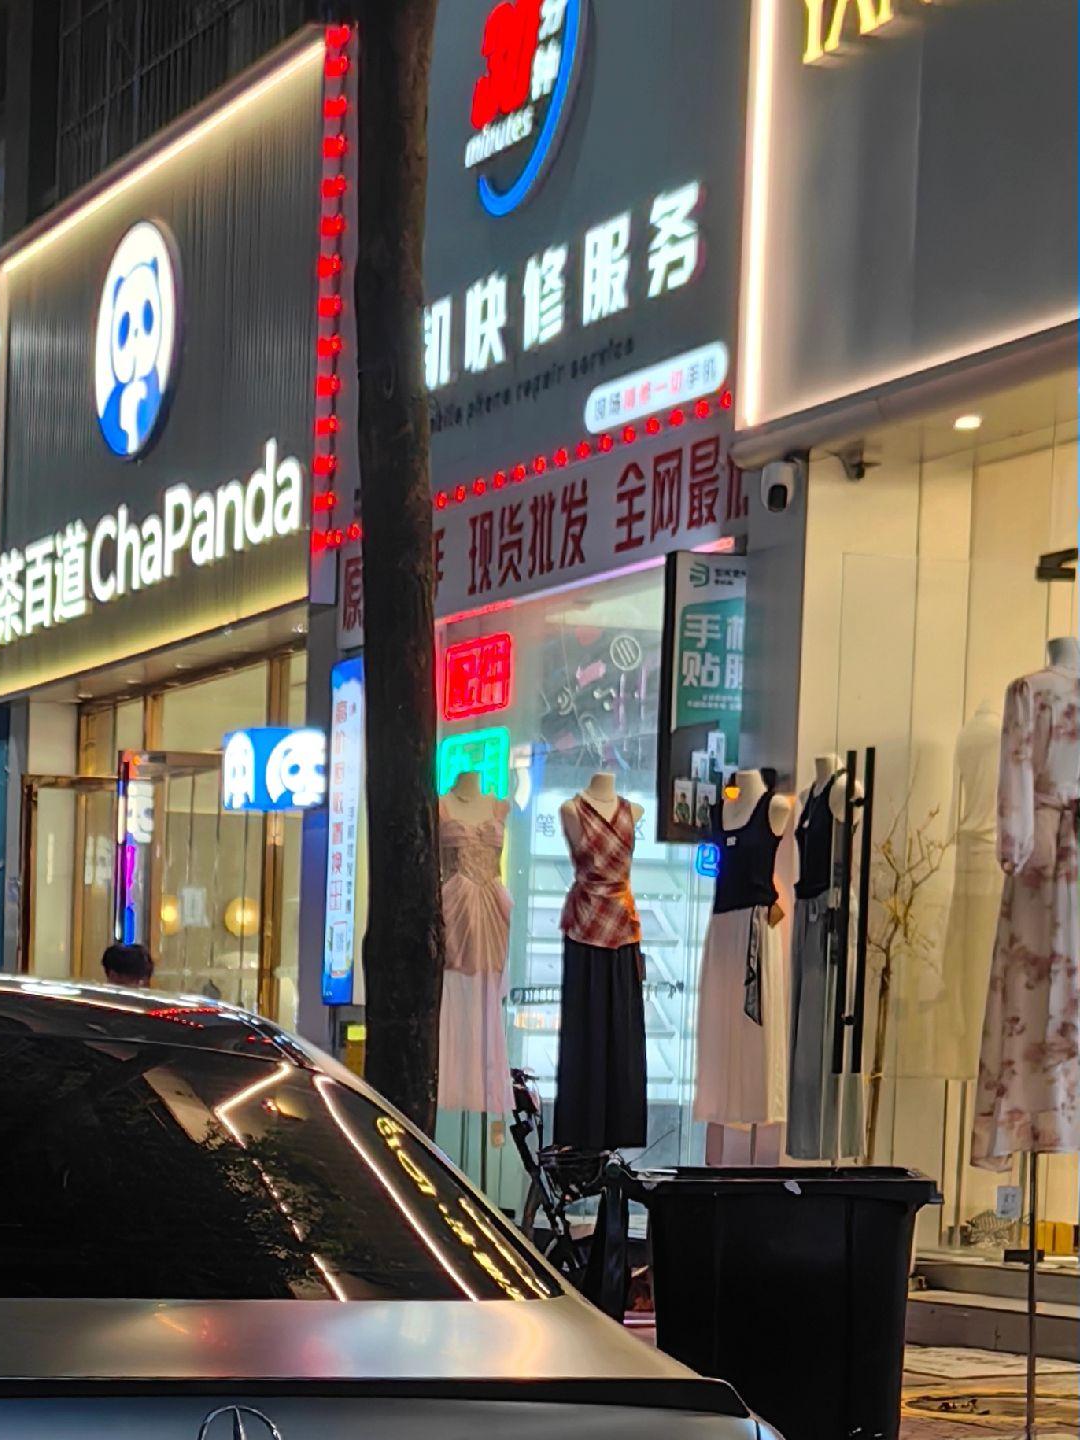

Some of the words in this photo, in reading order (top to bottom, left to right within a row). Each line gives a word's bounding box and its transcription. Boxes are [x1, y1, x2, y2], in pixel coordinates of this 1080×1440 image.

[465, 105, 535, 169] minutes
[90, 436, 304, 603] ChaPanda
[467, 477, 589, 597] 现货批发
